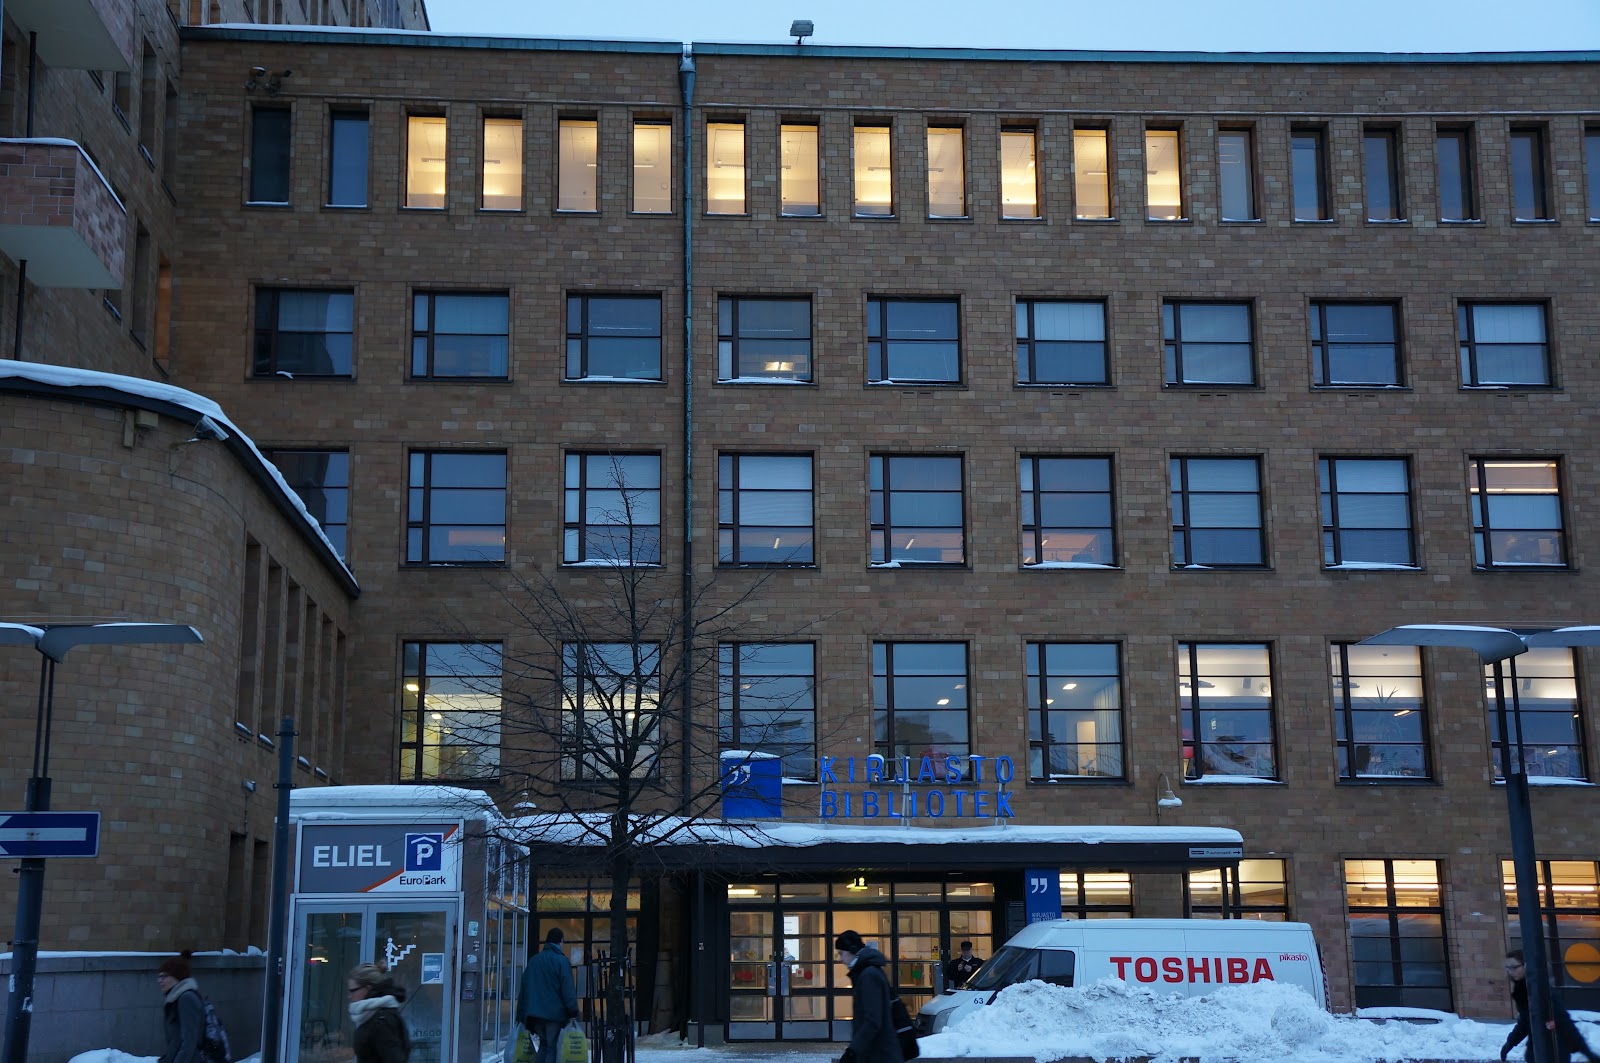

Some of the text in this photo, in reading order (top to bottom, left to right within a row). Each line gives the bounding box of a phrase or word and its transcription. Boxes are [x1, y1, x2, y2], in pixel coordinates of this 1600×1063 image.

[821, 755, 1015, 784] KIRJASTO
[821, 790, 1015, 818] BIBLIOTEK
[313, 845, 391, 867] ELIEL
[416, 843, 434, 866] P
[400, 874, 446, 885] EuroPark
[1279, 952, 1308, 962] pikasto
[1109, 956, 1275, 984] TOSHIBA
[973, 997, 984, 1005] 63
